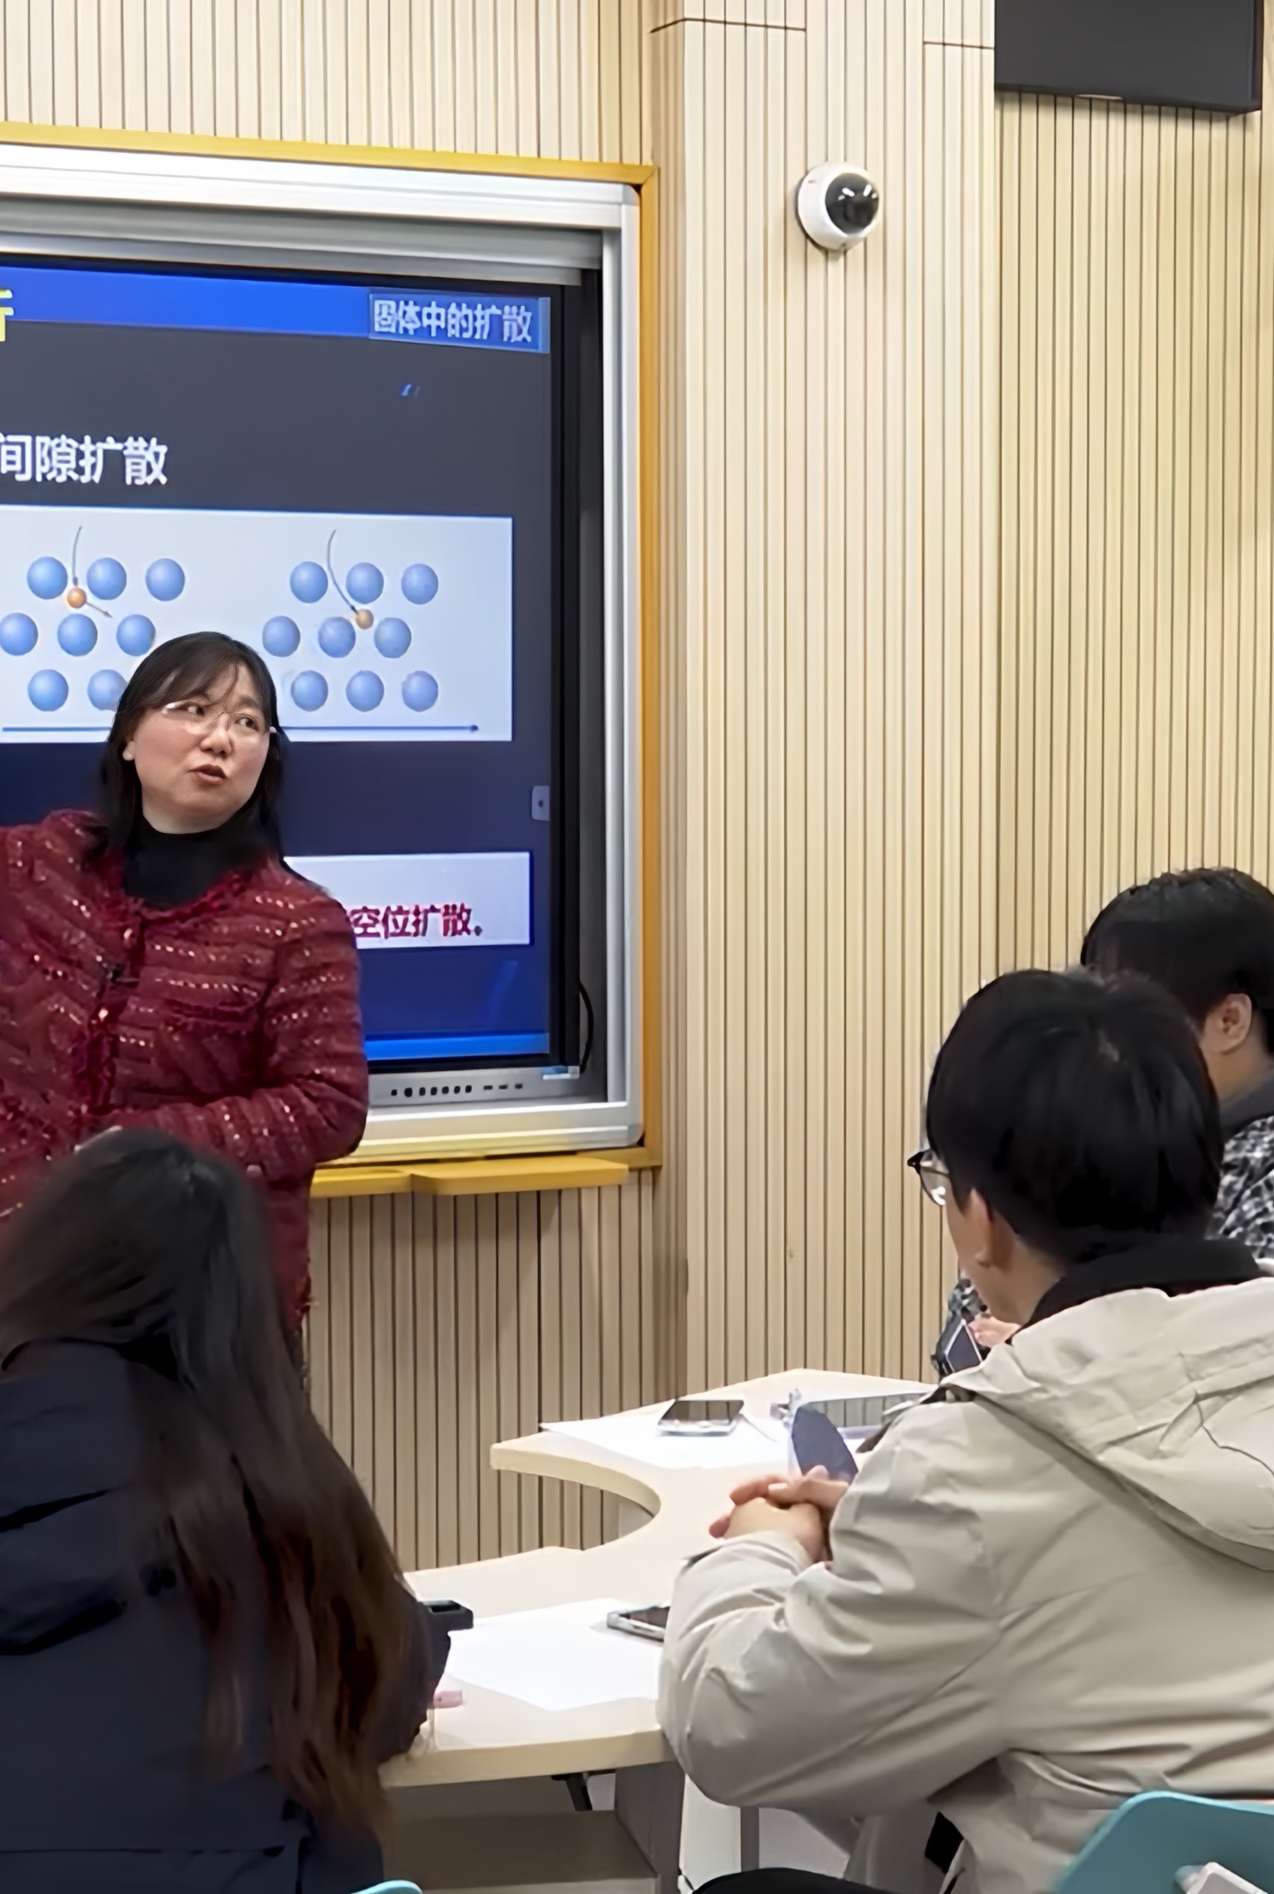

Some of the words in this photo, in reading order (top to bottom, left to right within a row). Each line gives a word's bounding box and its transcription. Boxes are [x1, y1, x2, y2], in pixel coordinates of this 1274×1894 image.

[373, 299, 533, 343] 固体中的扩散
[349, 902, 483, 940] 空位扩散。
